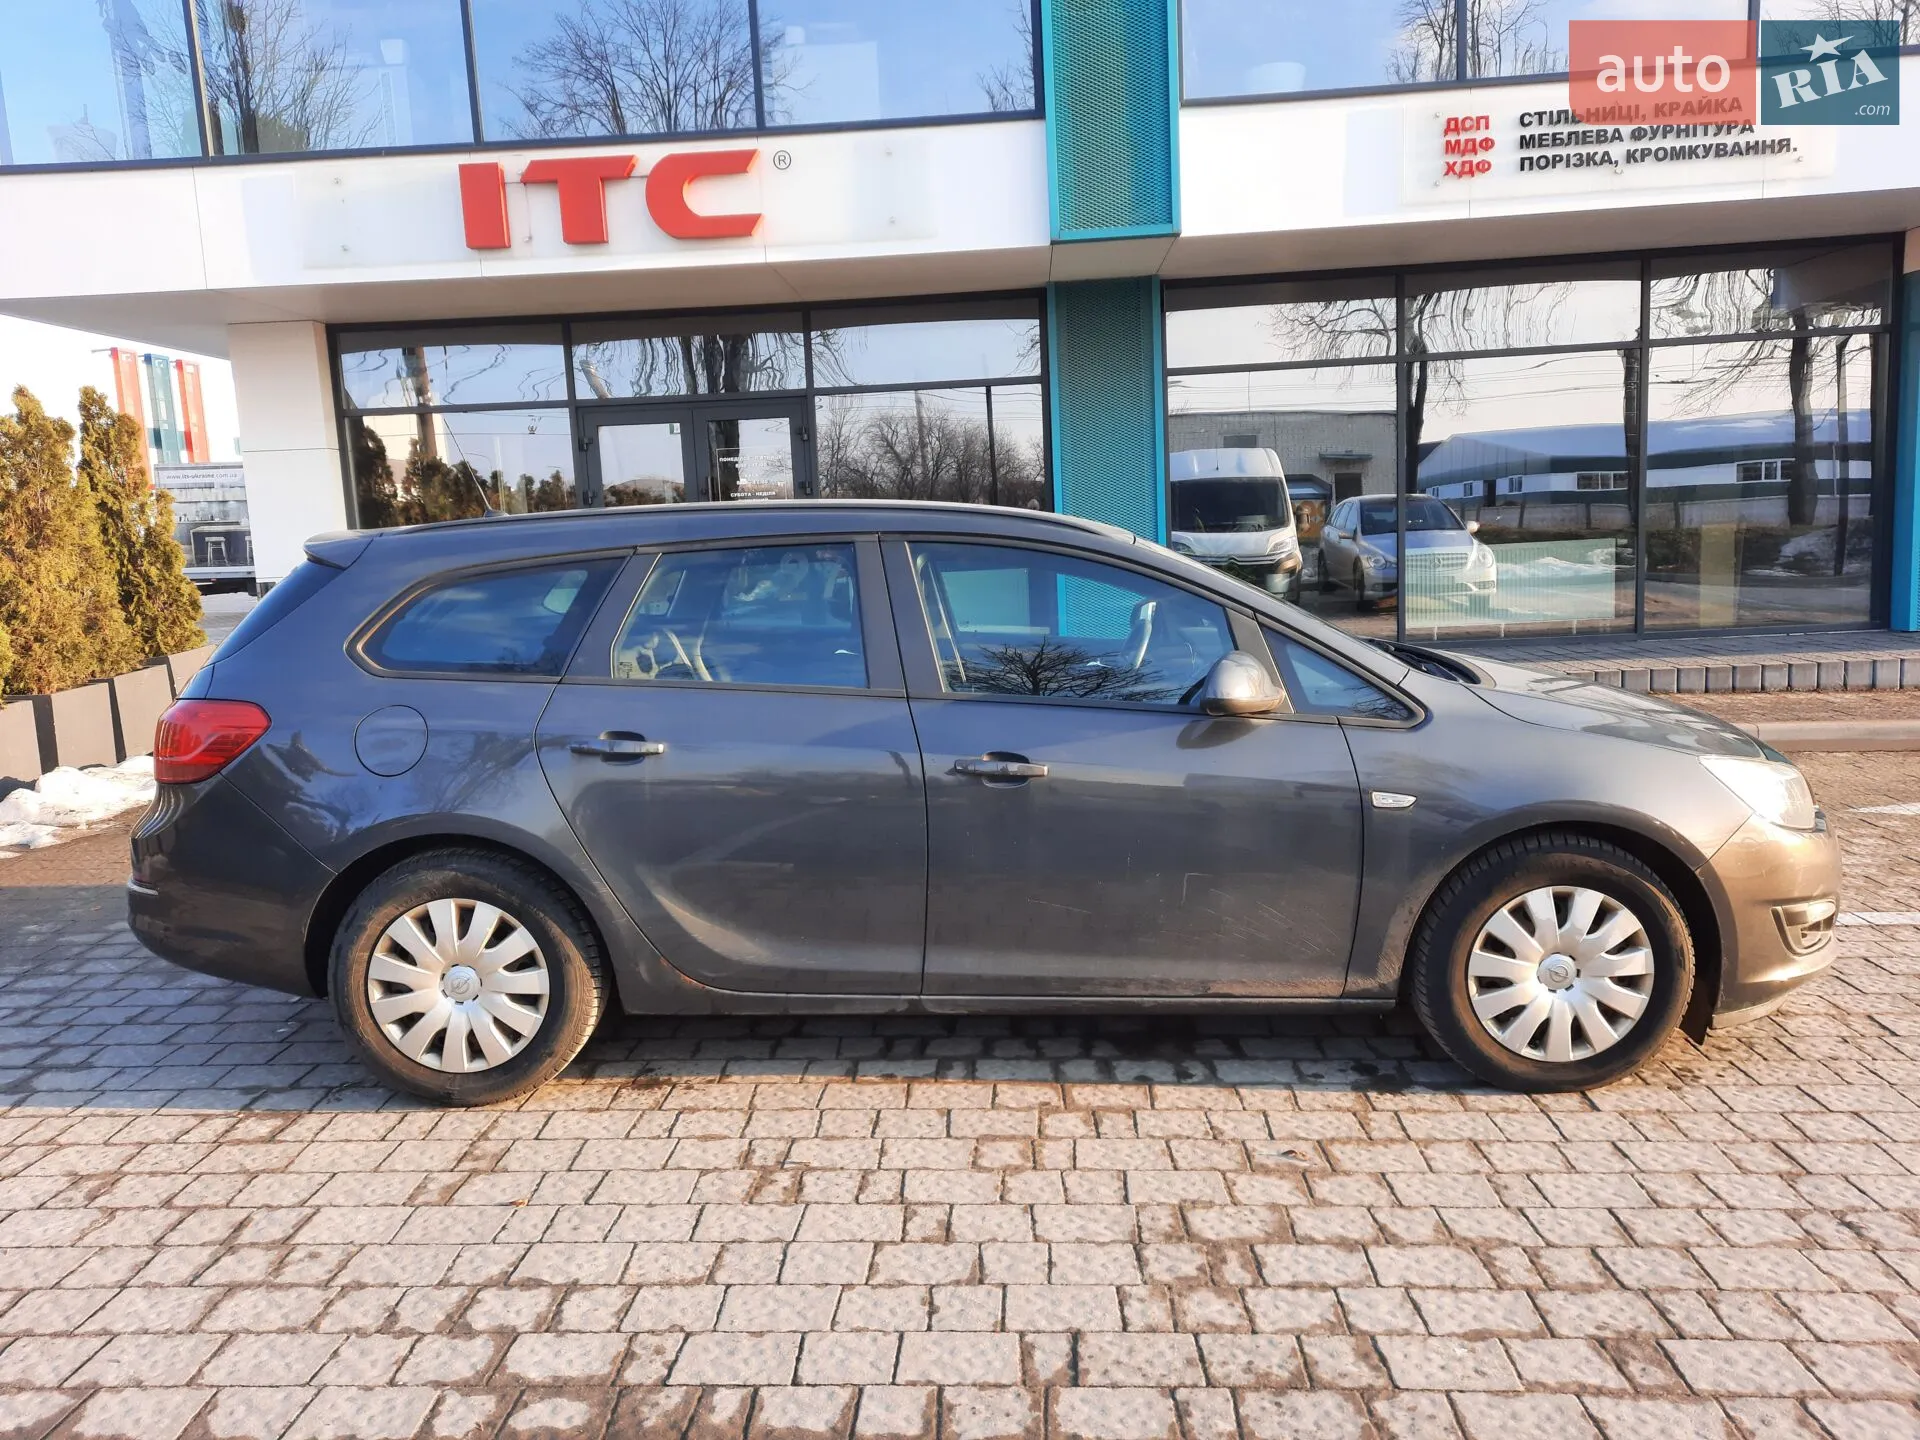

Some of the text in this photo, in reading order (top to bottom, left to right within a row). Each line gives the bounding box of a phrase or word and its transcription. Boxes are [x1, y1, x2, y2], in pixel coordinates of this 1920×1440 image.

[1519, 96, 1743, 128] СТІЛЬНИЦІ, КРАЙКА
[1443, 115, 1490, 137] ДСП
[1519, 118, 1755, 150] МЕБЛЕВА ФУРНІТУРА
[1445, 137, 1495, 157] МДФ
[1519, 137, 1798, 172] ПОРІЗКА, КРОМКУВАННЯ.
[1443, 159, 1492, 179] ХДФ
